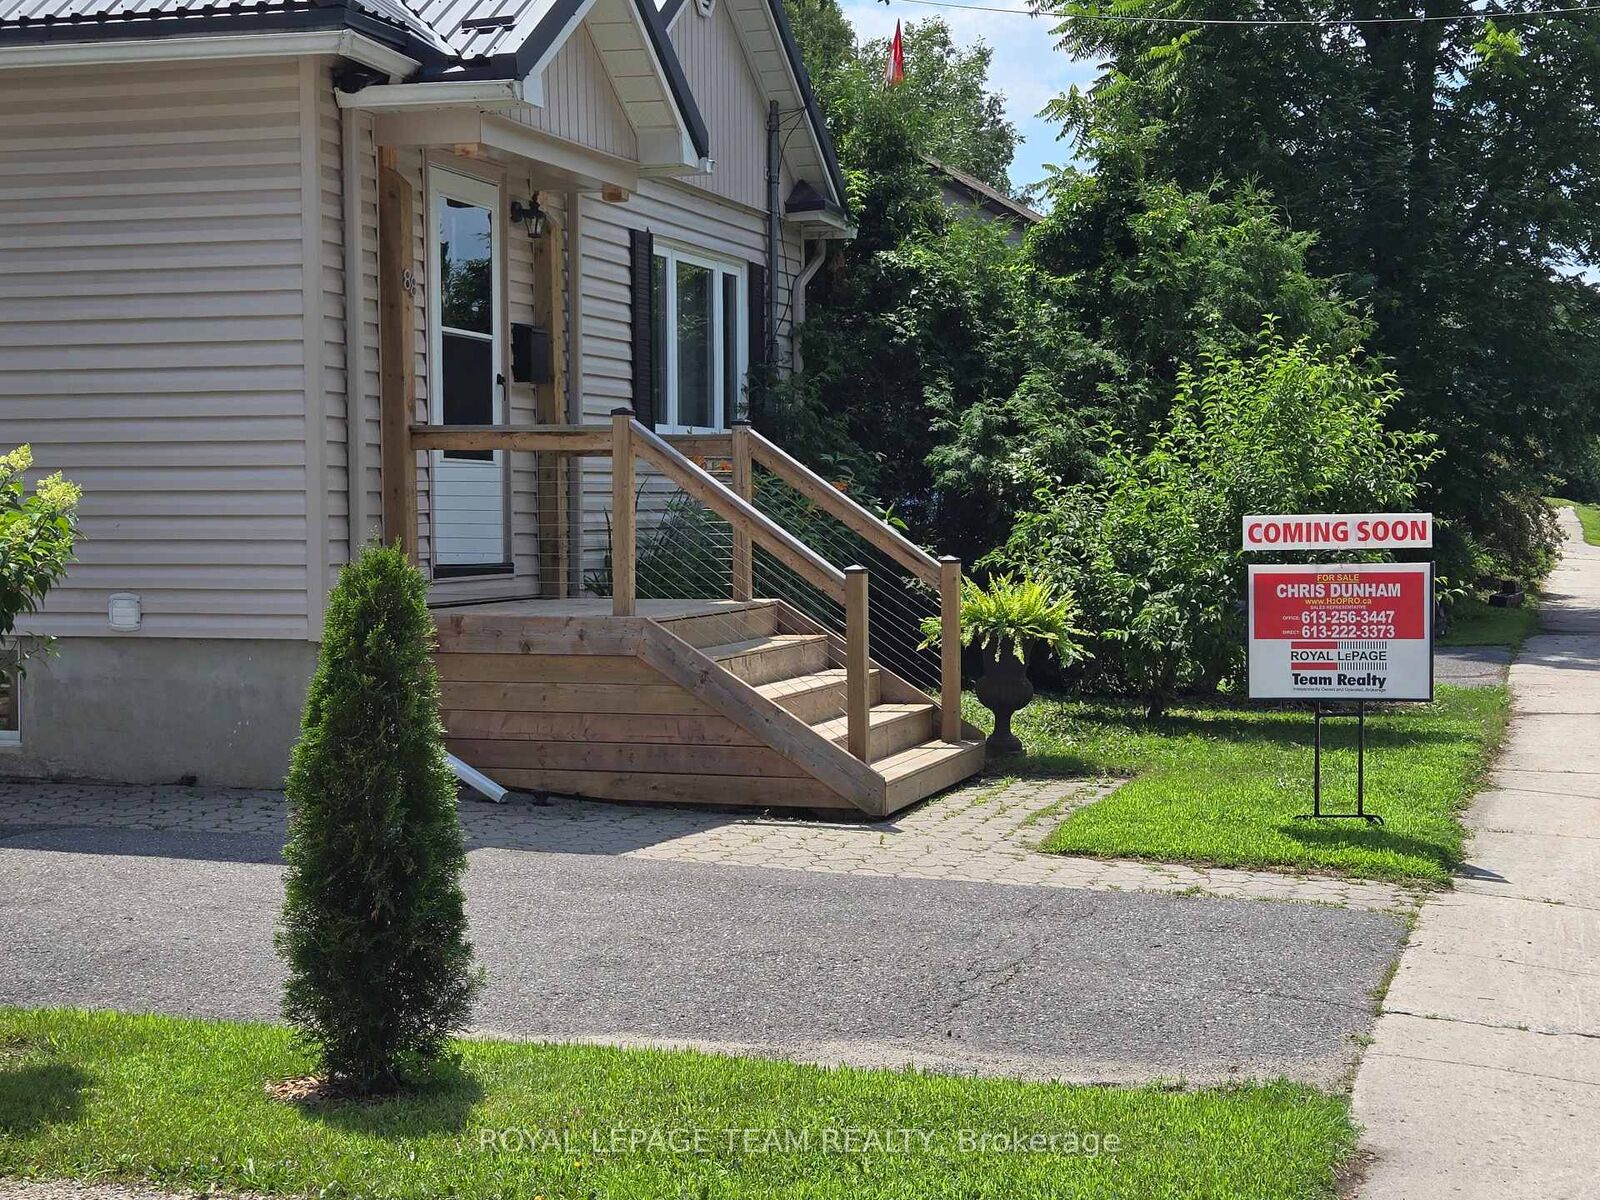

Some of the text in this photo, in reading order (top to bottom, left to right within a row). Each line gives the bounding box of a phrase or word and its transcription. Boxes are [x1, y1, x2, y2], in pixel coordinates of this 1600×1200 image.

[1248, 520, 1427, 543] COMING SOON
[1316, 573, 1360, 582] FOR SALE
[1276, 583, 1401, 598] CHRIS DUNHAM
[1301, 610, 1395, 624] 613-256-3447
[1301, 625, 1396, 639] 613-222-3373
[1290, 651, 1334, 661] ROYAL
[1292, 673, 1387, 689] Team Realty
